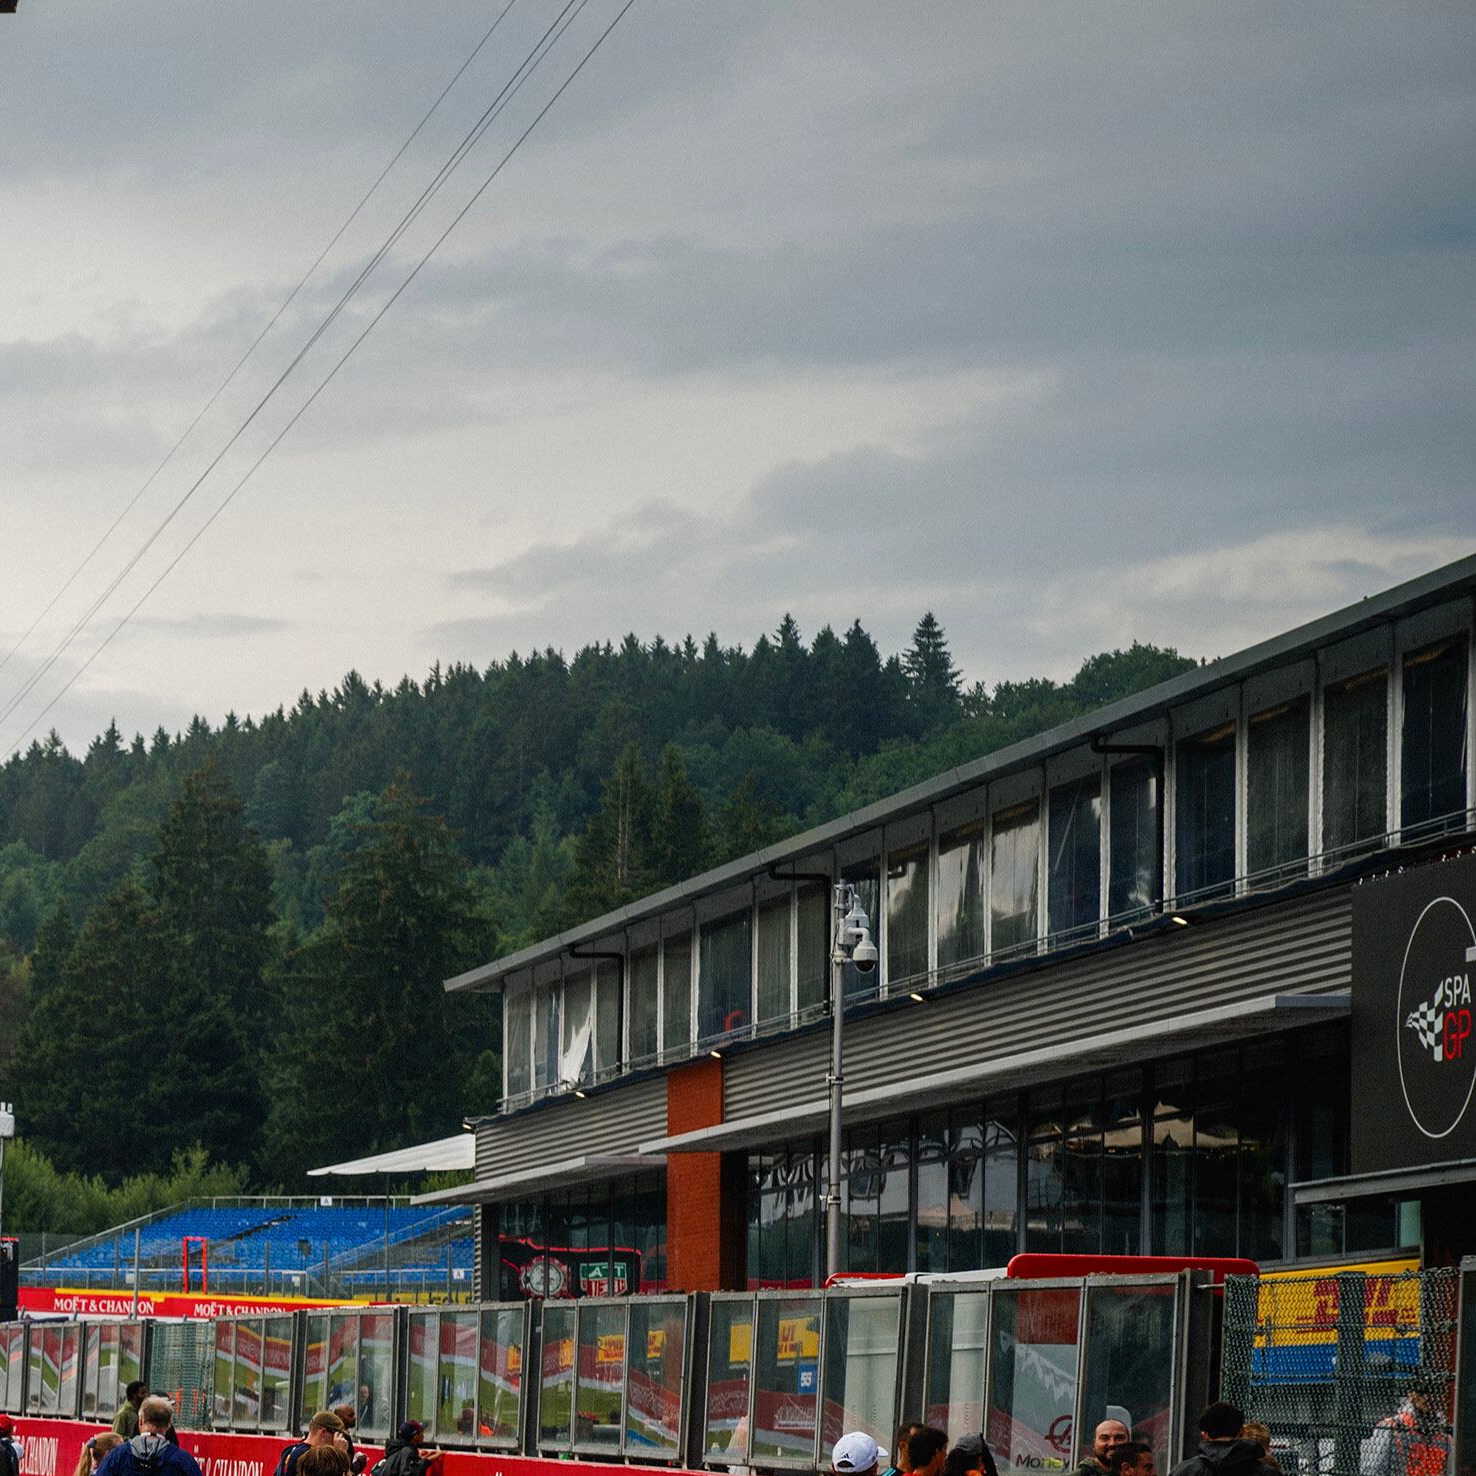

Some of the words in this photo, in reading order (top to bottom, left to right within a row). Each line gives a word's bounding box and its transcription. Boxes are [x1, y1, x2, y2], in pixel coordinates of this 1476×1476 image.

[1444, 973, 1471, 1008] SPA
[1443, 1009, 1472, 1060] GP
[53, 1296, 87, 1312] MOËT
[88, 1300, 97, 1311] &
[193, 1301, 226, 1317] MOËT
[24, 1436, 58, 1476] CHANDON
